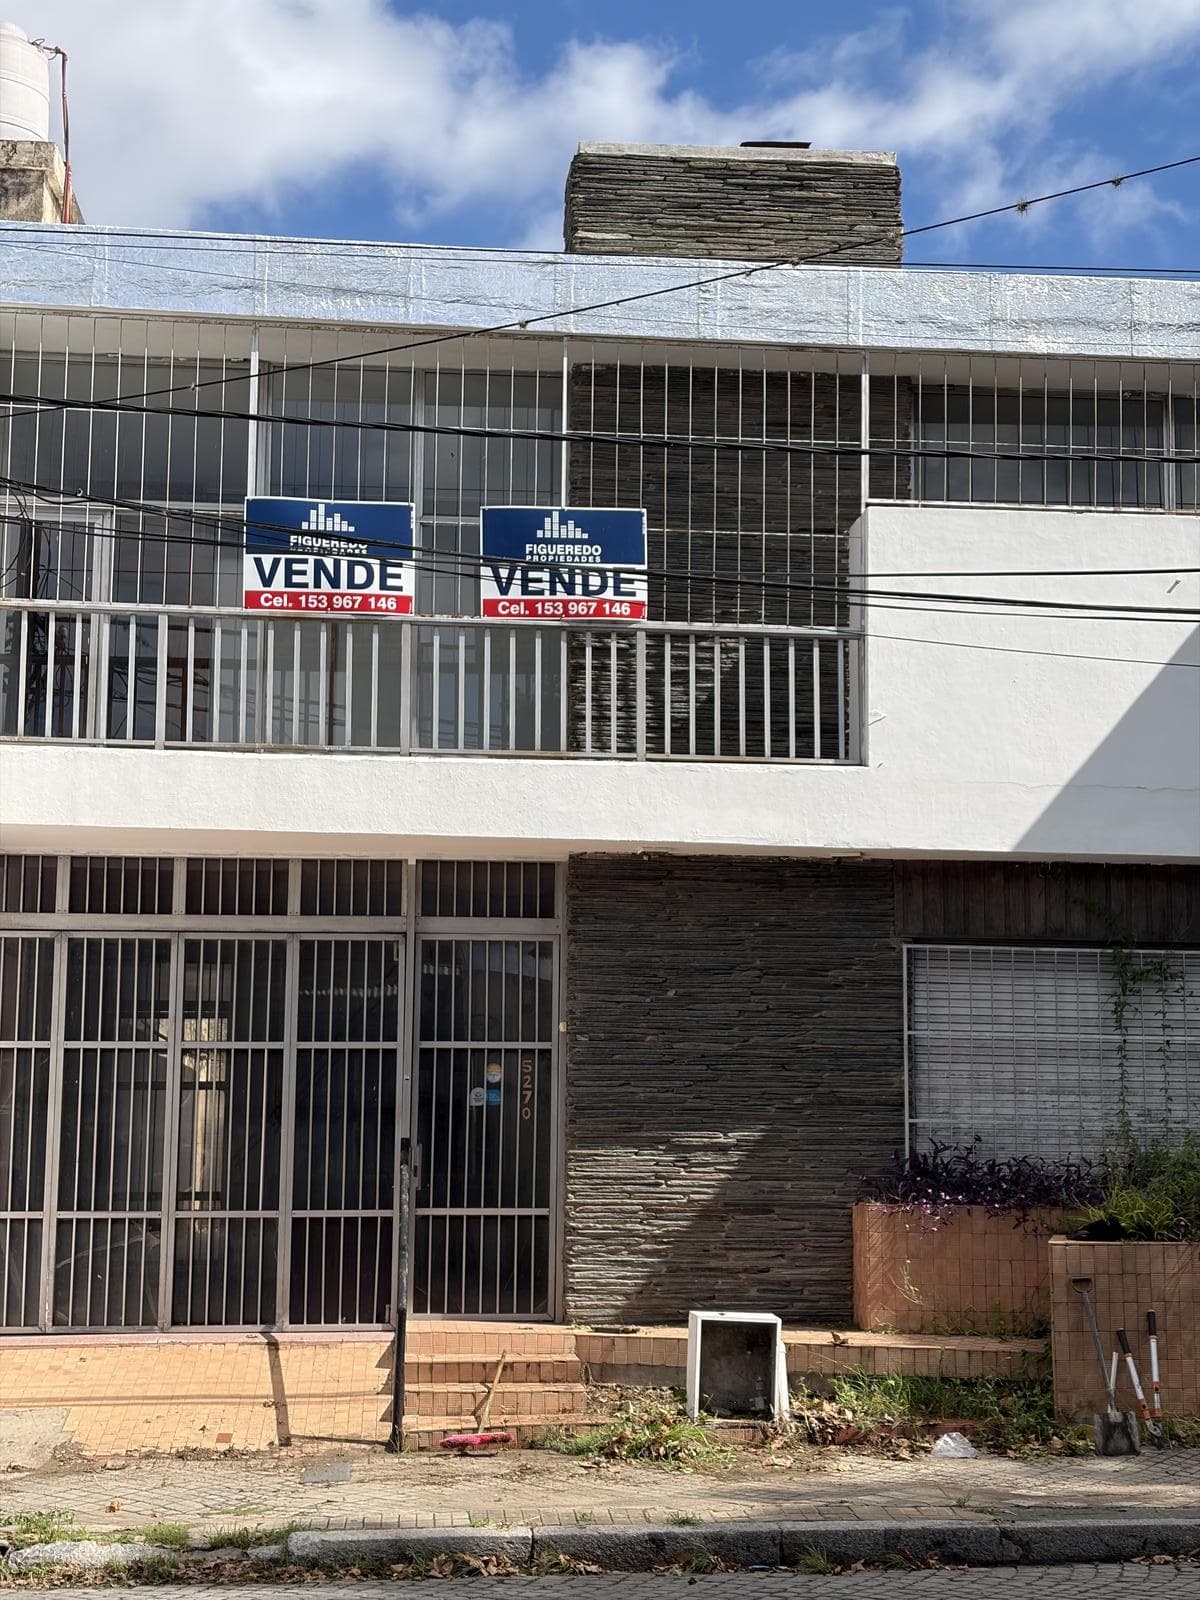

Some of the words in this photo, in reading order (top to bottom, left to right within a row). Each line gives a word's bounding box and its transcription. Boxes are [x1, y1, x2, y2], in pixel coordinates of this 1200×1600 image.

[525, 543, 602, 556] FIGUEREDO
[525, 555, 601, 563] PROPIEDADES
[253, 557, 404, 592] VENDE
[490, 565, 637, 598] VENDE
[259, 593, 293, 608] Cel.
[299, 595, 328, 608] 153
[332, 595, 362, 609] 967
[368, 596, 397, 610] 146
[497, 601, 530, 615] Cel.
[535, 602, 563, 615] 153
[568, 602, 597, 615] 967
[602, 602, 631, 616] 146
[521, 1059, 533, 1120] 5270
